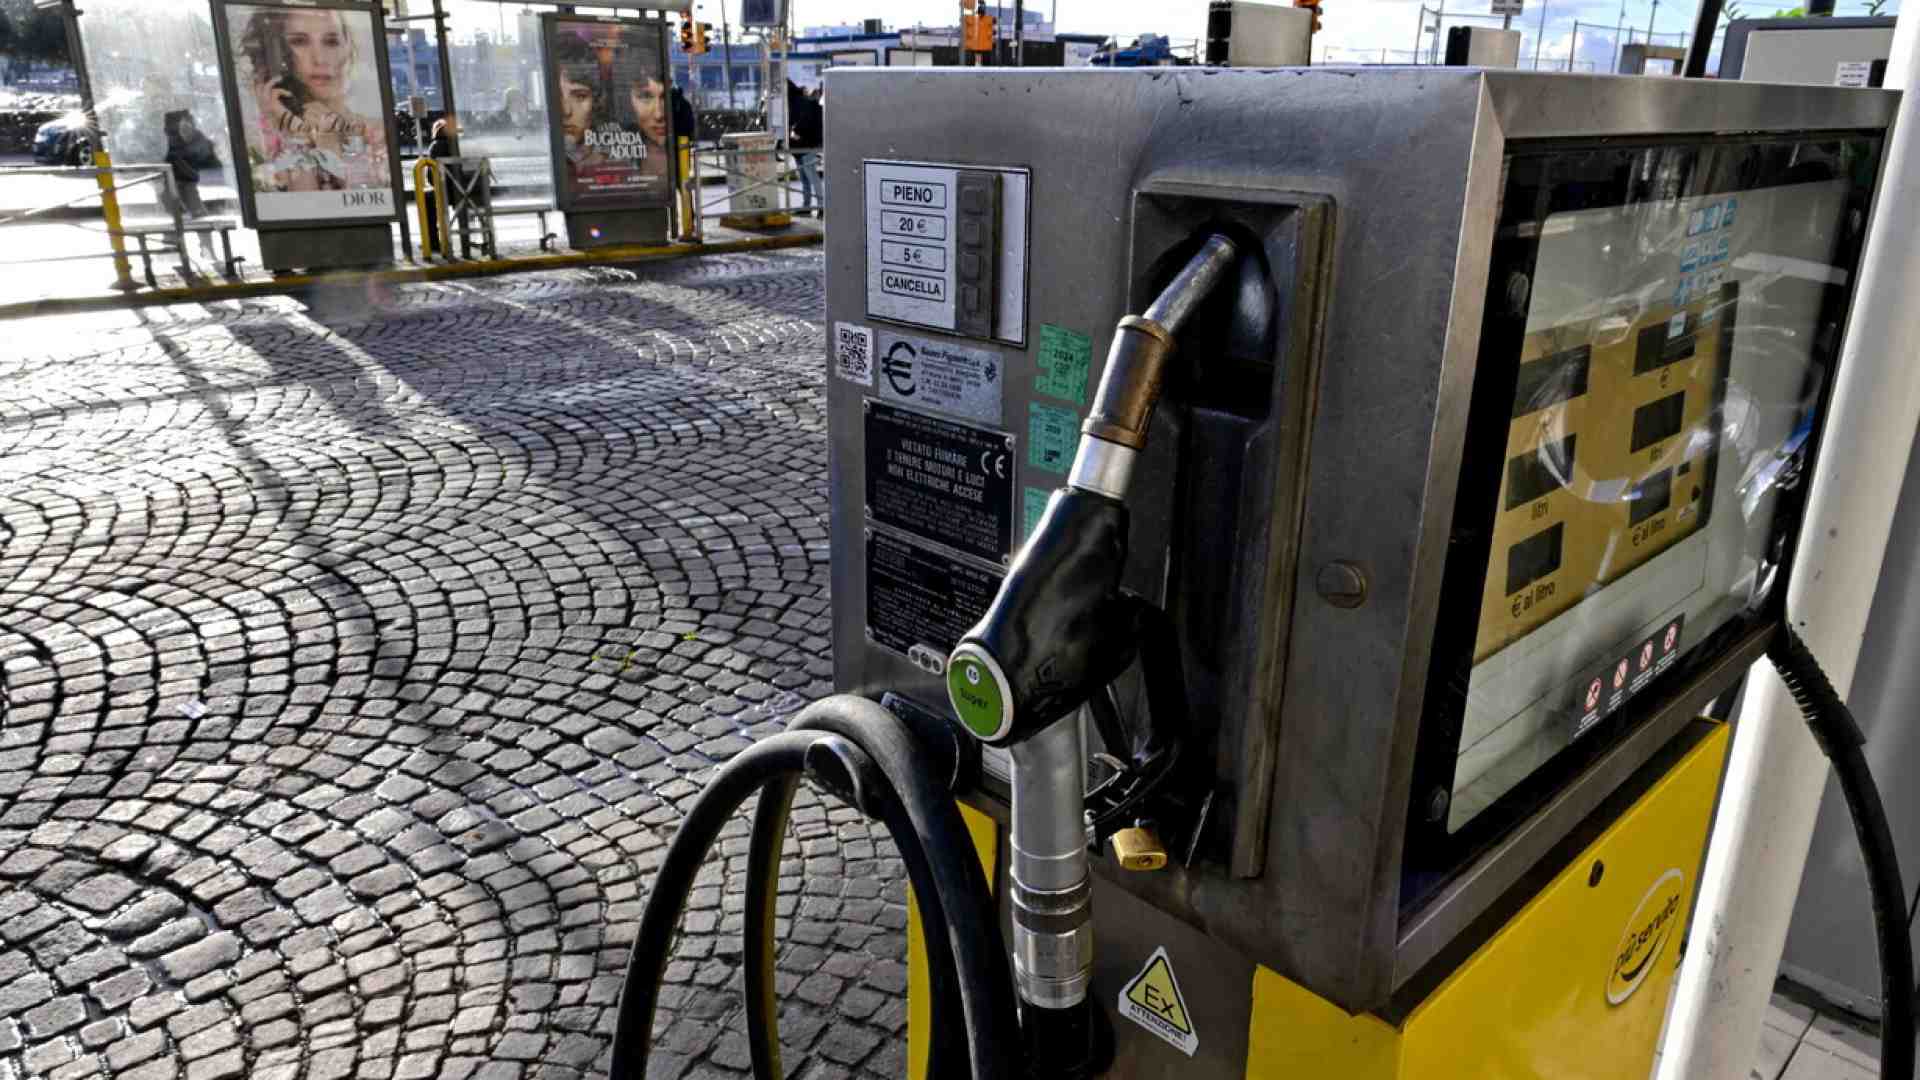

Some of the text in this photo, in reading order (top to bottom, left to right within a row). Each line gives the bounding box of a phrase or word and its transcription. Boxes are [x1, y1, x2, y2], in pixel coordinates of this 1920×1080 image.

[584, 129, 643, 145] BUGIARDA
[609, 144, 648, 160] ADULTI
[342, 192, 385, 207] DIOR
[894, 185, 933, 203] PIENO
[900, 217, 928, 233] 20 €
[903, 248, 922, 263] 5 €
[885, 275, 941, 296] CANCELLA
[1511, 594, 1522, 618] €
